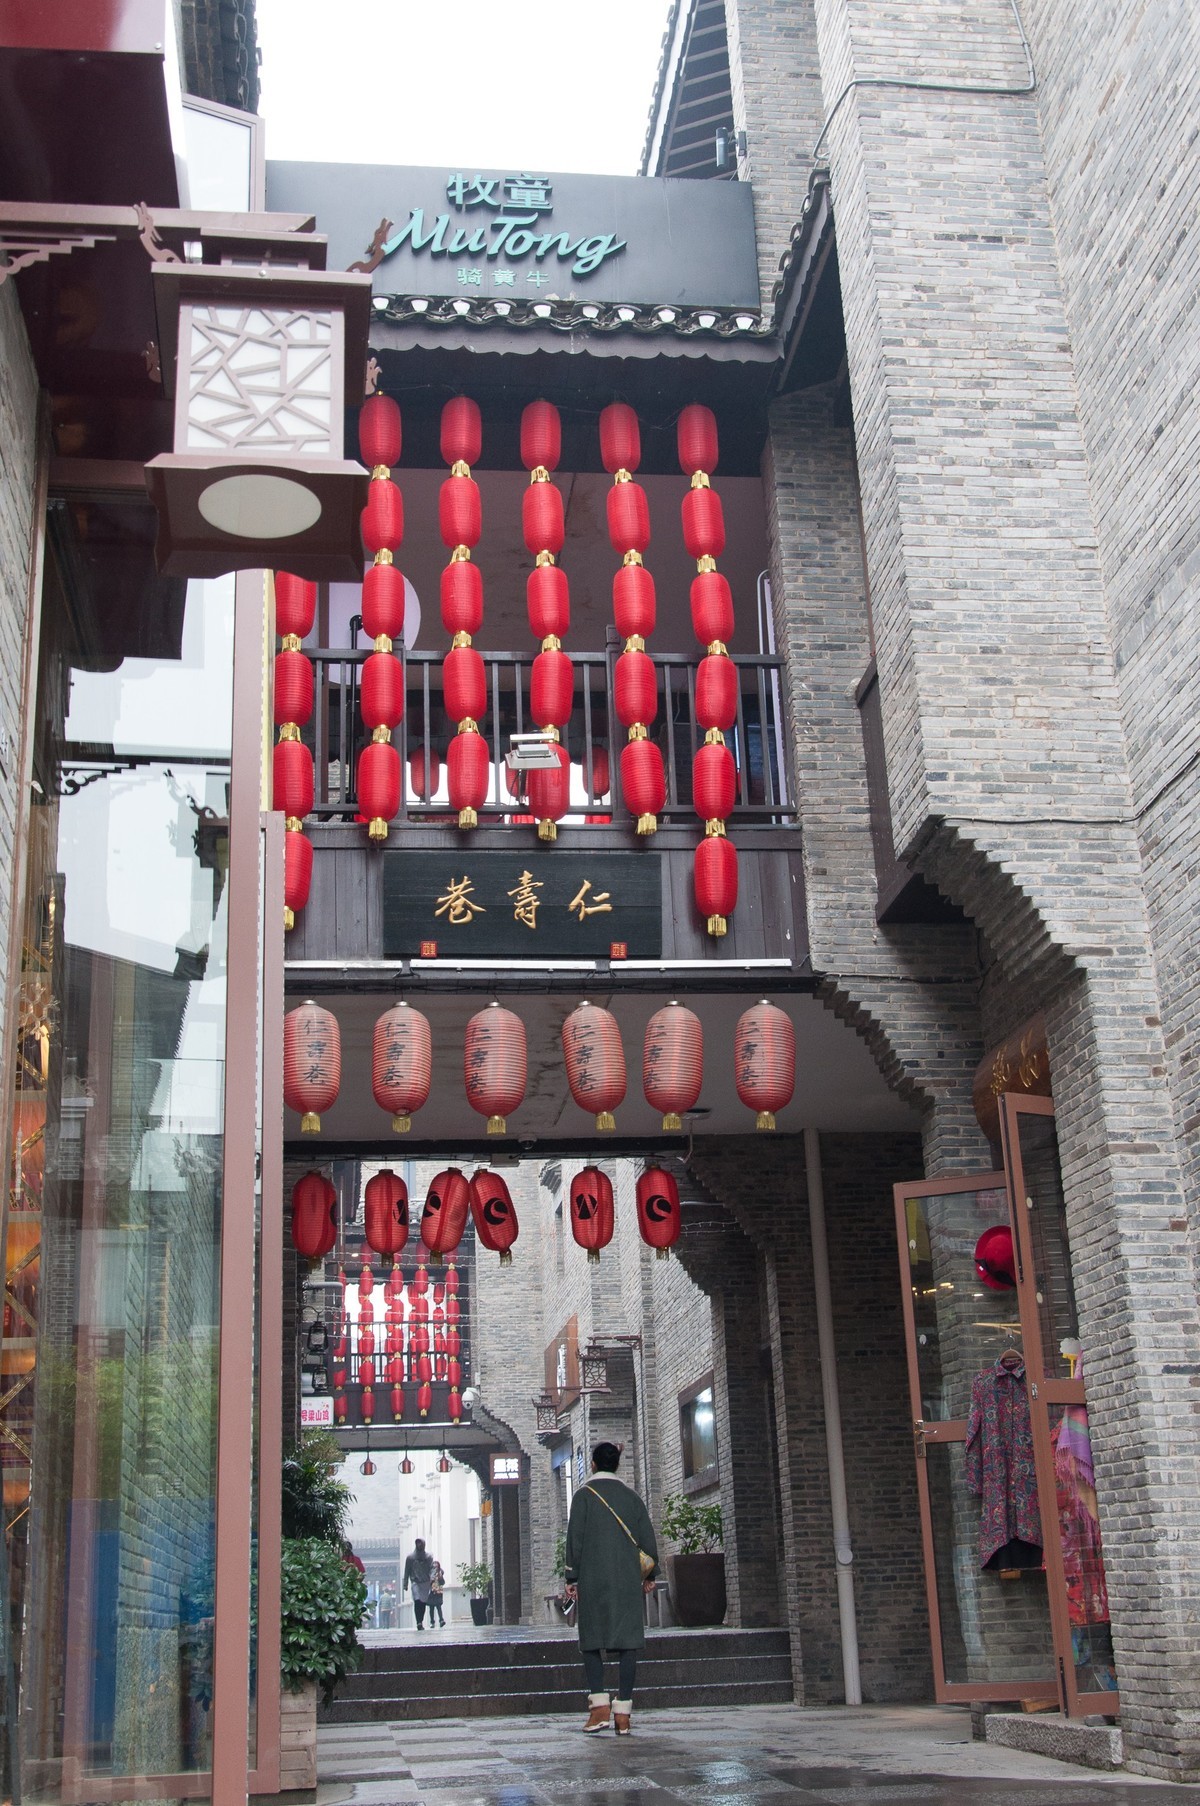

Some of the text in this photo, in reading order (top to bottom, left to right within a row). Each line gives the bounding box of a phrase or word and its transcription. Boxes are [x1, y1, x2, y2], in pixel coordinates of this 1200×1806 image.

[446, 173, 554, 211] 牧童
[383, 207, 628, 277] MuTong
[457, 267, 550, 288] 骑黄牛
